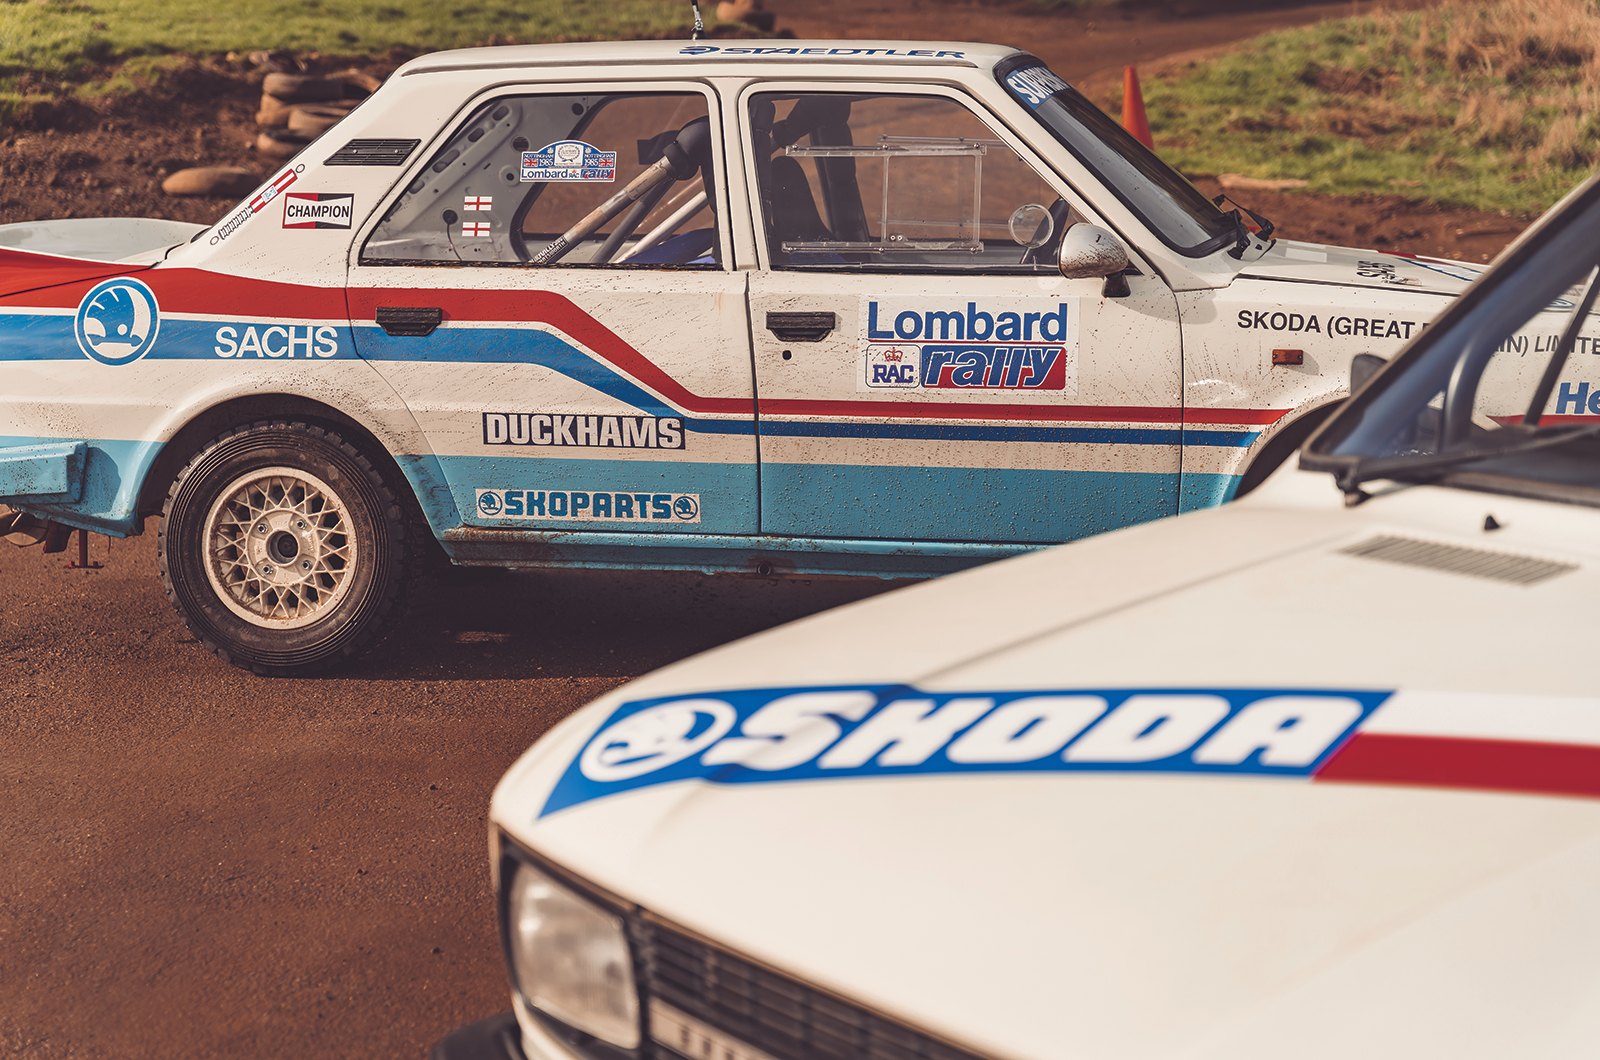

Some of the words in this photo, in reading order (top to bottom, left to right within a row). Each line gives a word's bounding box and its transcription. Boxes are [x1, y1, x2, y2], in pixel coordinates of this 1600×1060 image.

[720, 47, 965, 59] STAEDTLER
[521, 169, 568, 179] Lombard
[580, 169, 615, 179] rally
[539, 158, 553, 167] 1985
[584, 158, 598, 167] 1985
[287, 205, 350, 218] CHAMPION
[867, 301, 1068, 342] Lombard
[1237, 310, 1322, 334] SKODA
[1326, 316, 1416, 340] (GREAT
[214, 326, 338, 359] SACHS
[872, 364, 914, 384] RAC
[924, 347, 1063, 388] rally
[486, 412, 683, 449] DUCKHAMS
[504, 491, 673, 519] SKOPARTS
[701, 691, 1364, 771] SKODA
